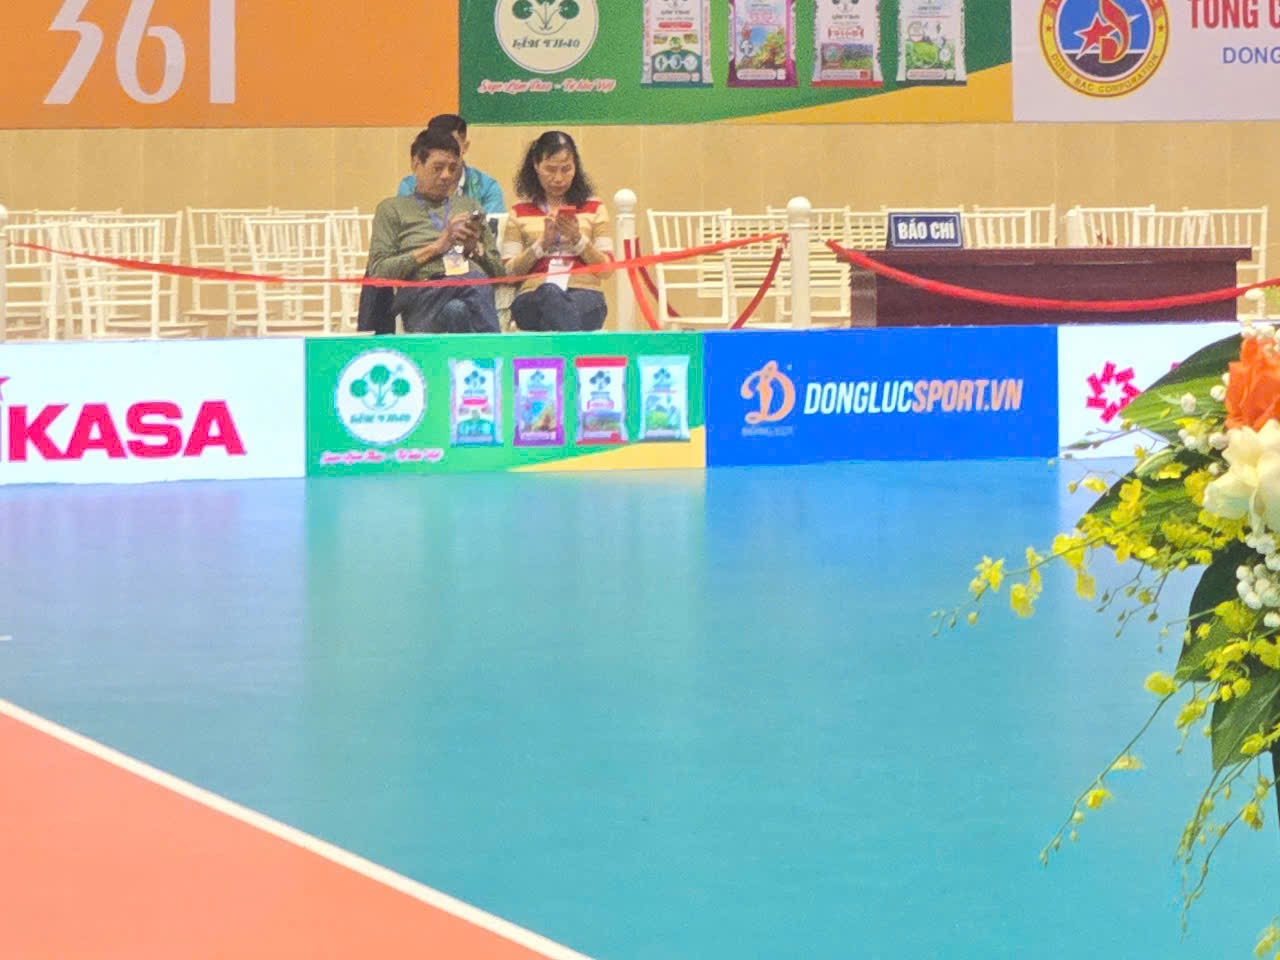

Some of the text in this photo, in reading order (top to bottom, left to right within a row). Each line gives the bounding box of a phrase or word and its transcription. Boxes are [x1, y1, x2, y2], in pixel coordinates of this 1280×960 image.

[897, 218, 955, 240] BÁO CHÍ
[804, 378, 1023, 414] DONGLUCSPORT.VN
[0, 399, 247, 463] KASA
